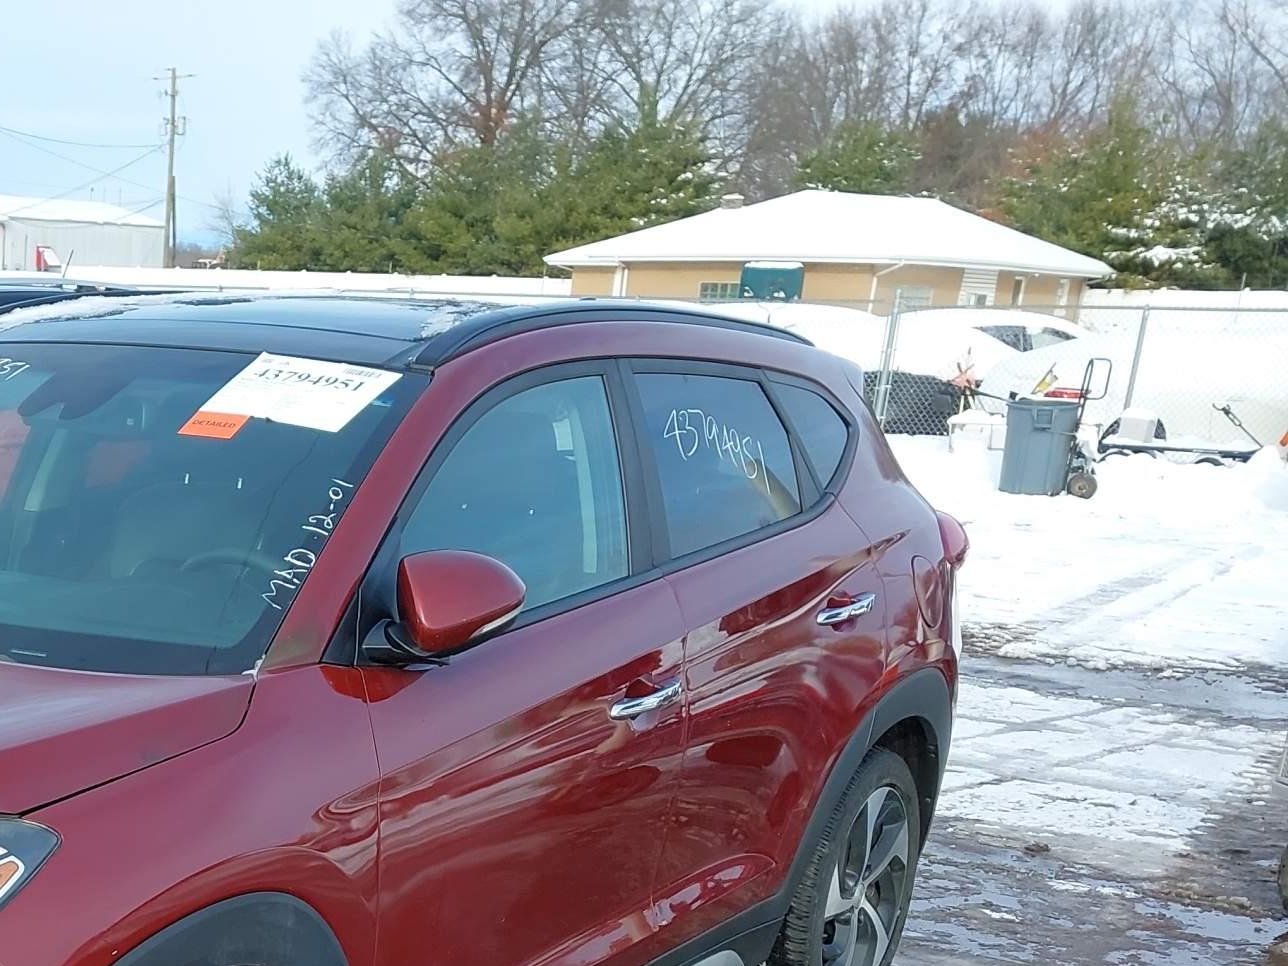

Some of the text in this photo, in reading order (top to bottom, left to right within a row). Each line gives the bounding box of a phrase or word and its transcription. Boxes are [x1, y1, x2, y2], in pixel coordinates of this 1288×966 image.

[253, 367, 366, 391] 43794951
[191, 418, 237, 429] DETAILED
[663, 408, 771, 495] 43794951
[262, 478, 354, 610] MAD 12-01
